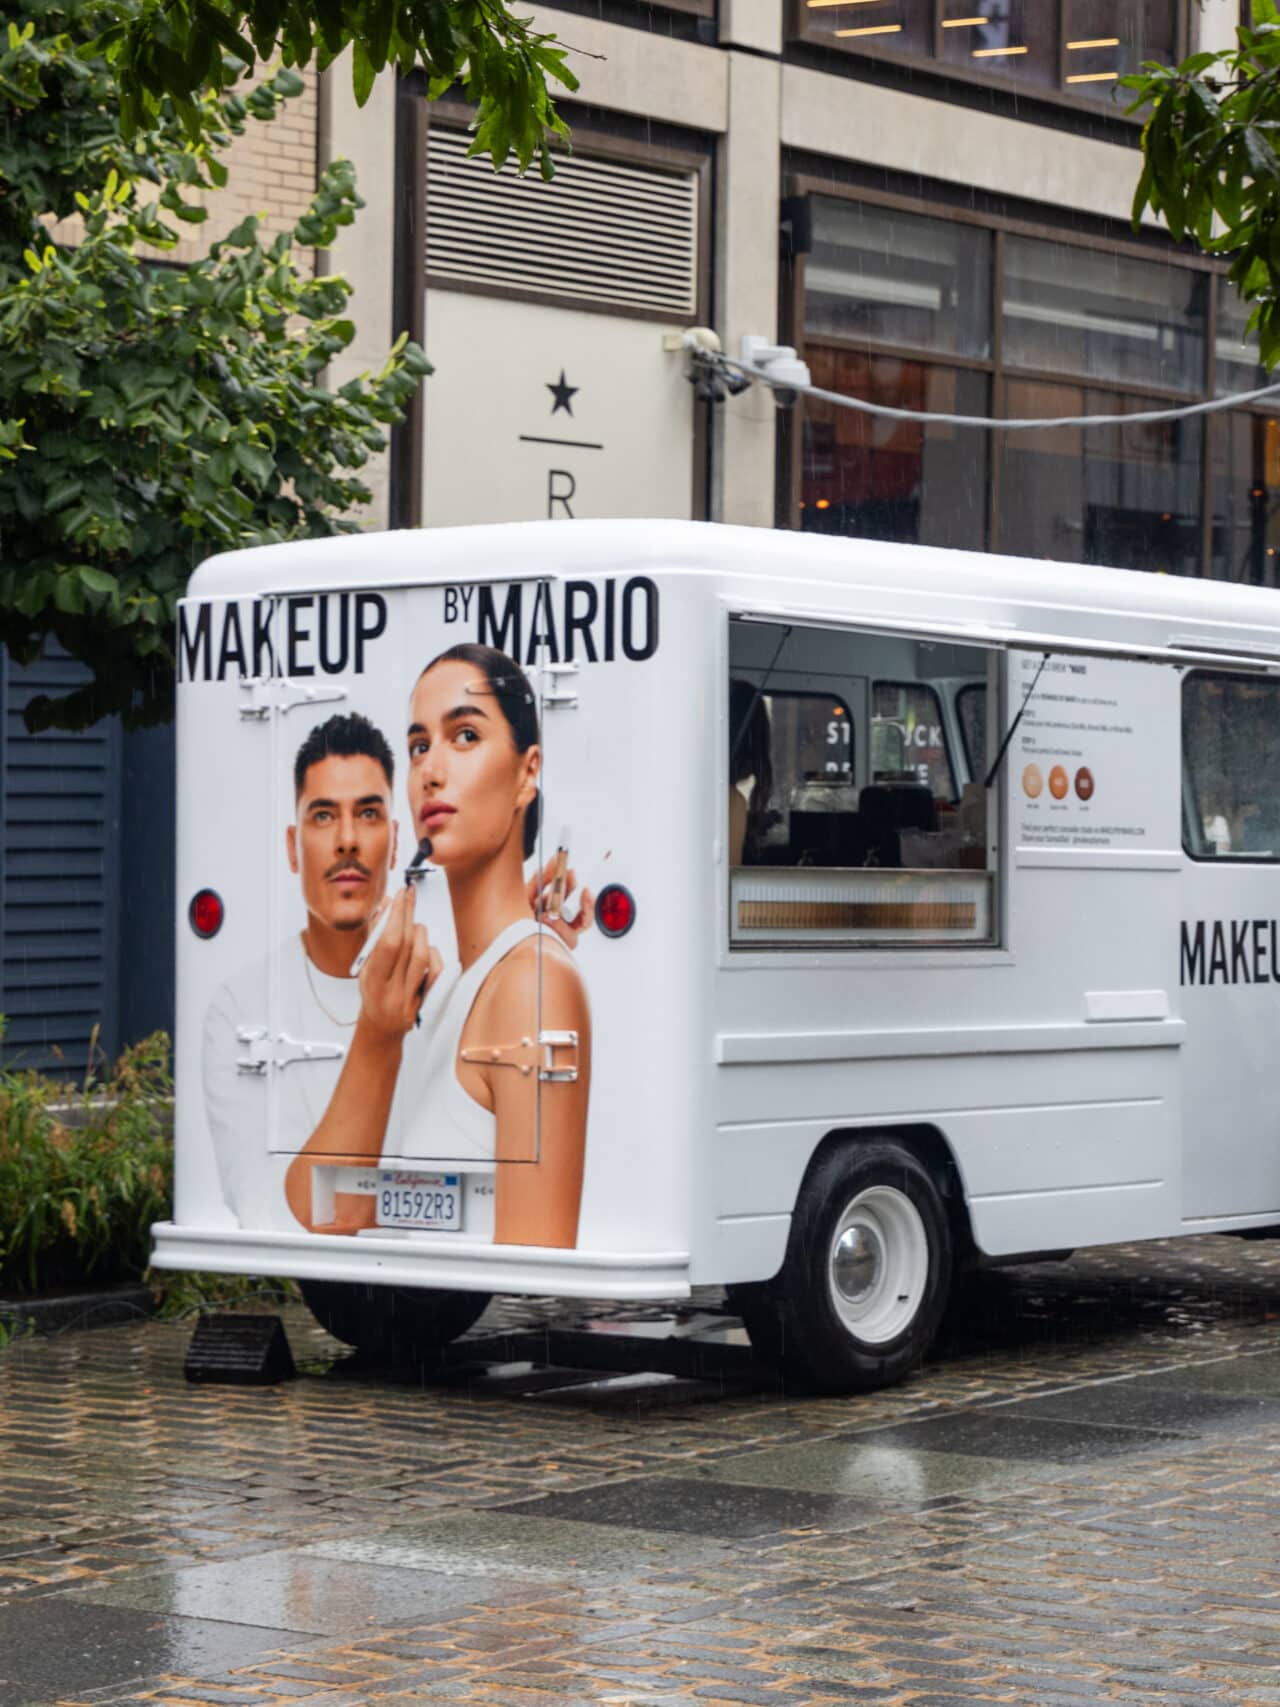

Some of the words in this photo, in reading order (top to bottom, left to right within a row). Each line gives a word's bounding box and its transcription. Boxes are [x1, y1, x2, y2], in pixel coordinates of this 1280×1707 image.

[548, 469, 576, 520] R
[176, 592, 388, 682] MAKEUP
[443, 586, 474, 624] BY
[477, 575, 660, 665] MARIO
[382, 1190, 455, 1220] 81592R3
